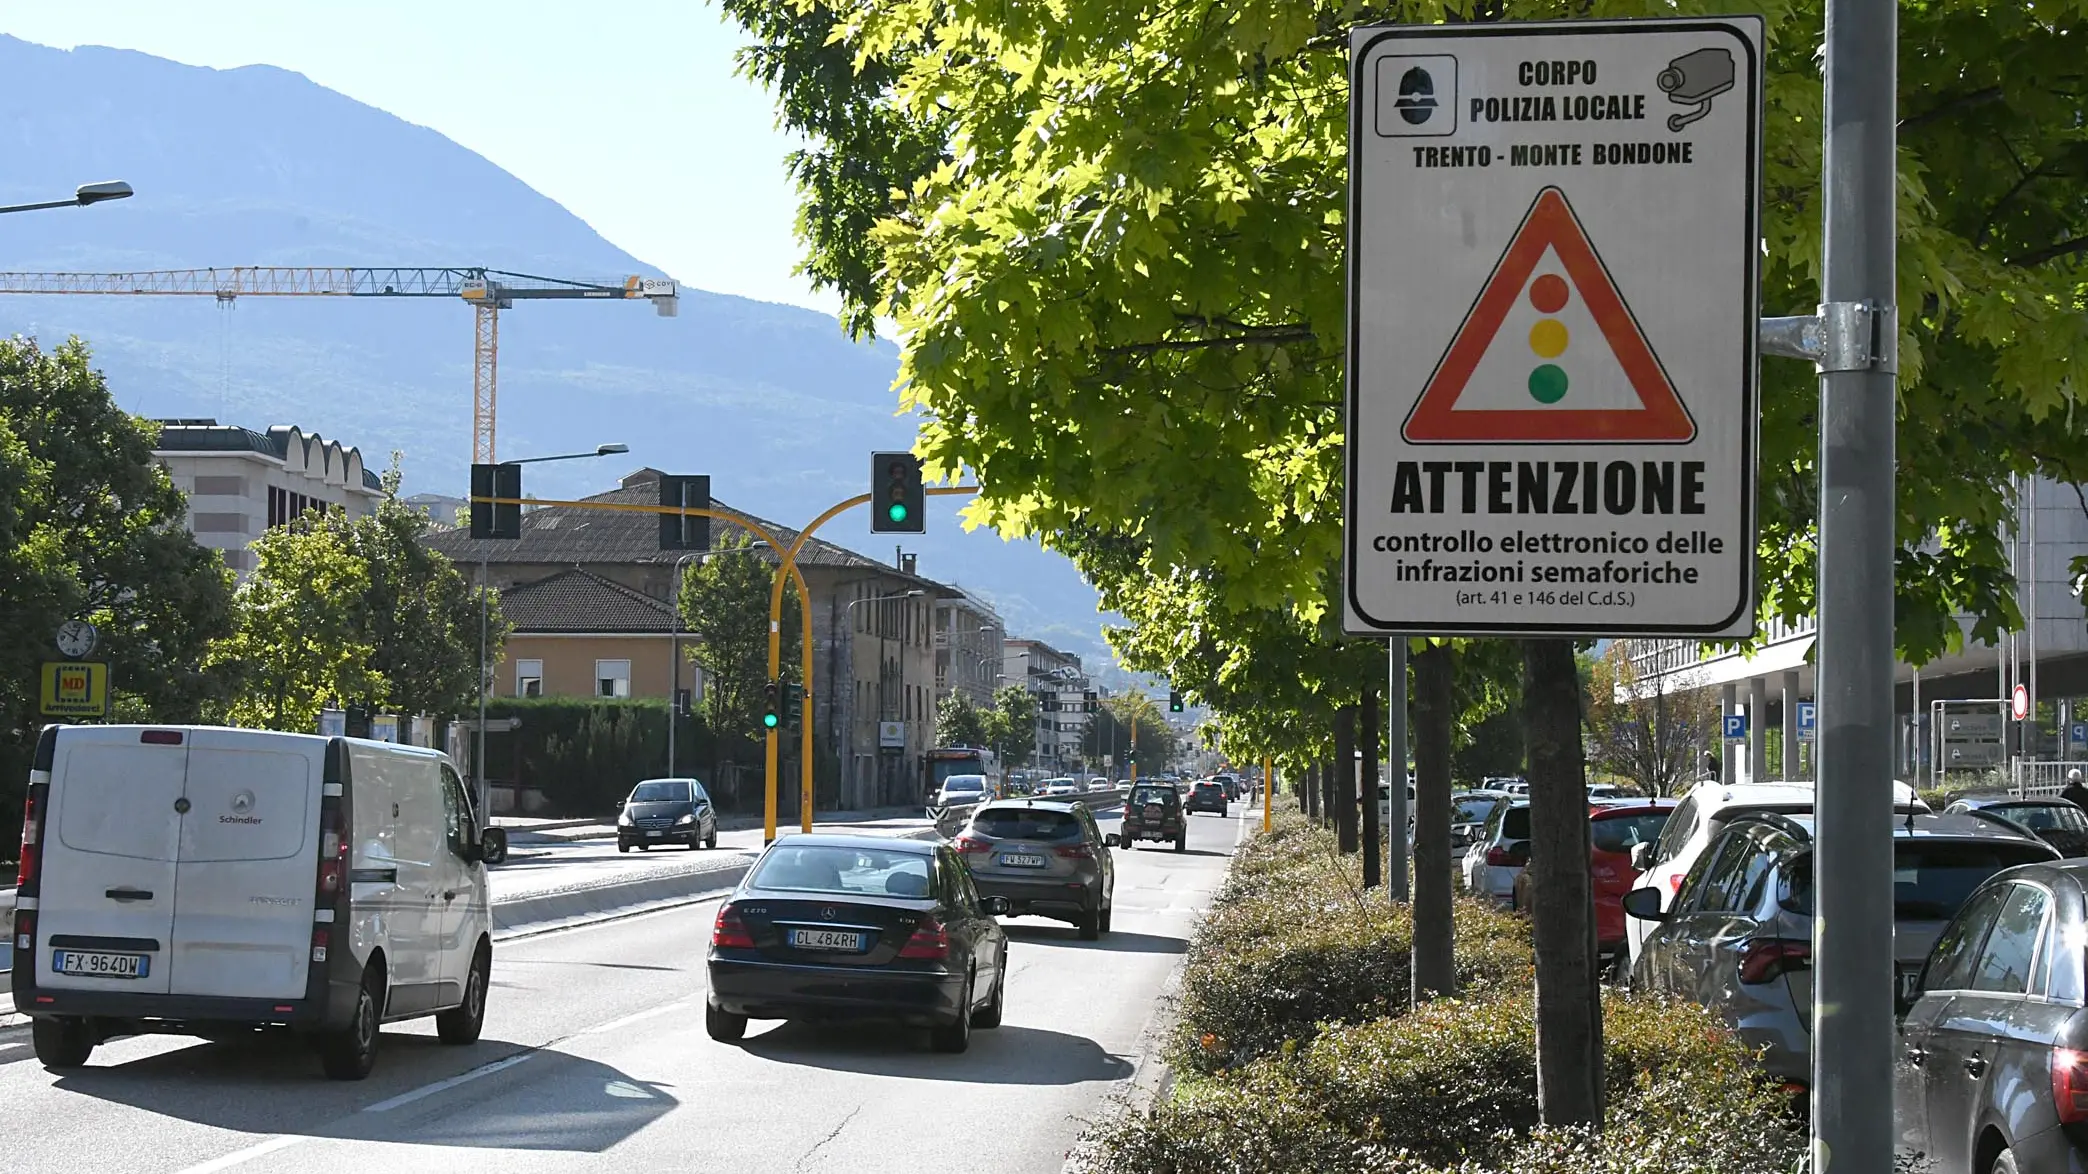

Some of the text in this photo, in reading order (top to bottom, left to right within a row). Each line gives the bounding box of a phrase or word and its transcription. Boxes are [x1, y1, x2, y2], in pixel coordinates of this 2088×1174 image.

[1518, 59, 1597, 86] CORPO
[1470, 94, 1646, 123] POLIZIA LOCALE
[1412, 145, 1491, 168] TRENTO
[1510, 143, 1582, 167] MONTE
[1592, 141, 1693, 166] BONDONE
[1390, 460, 1706, 516] ATTENZIONE
[1372, 529, 1724, 555] controllo elettronico delle
[1396, 558, 1699, 584] infrazioni semaforiche
[1456, 589, 1635, 608] (art. 41 e 146 del C.d.S.)
[62, 678, 85, 690] MD
[1801, 706, 1815, 726] P
[1727, 718, 1740, 735] P
[219, 816, 263, 825] Schindler
[796, 931, 857, 948] CL 484RH
[65, 954, 138, 973] FX 964DW
